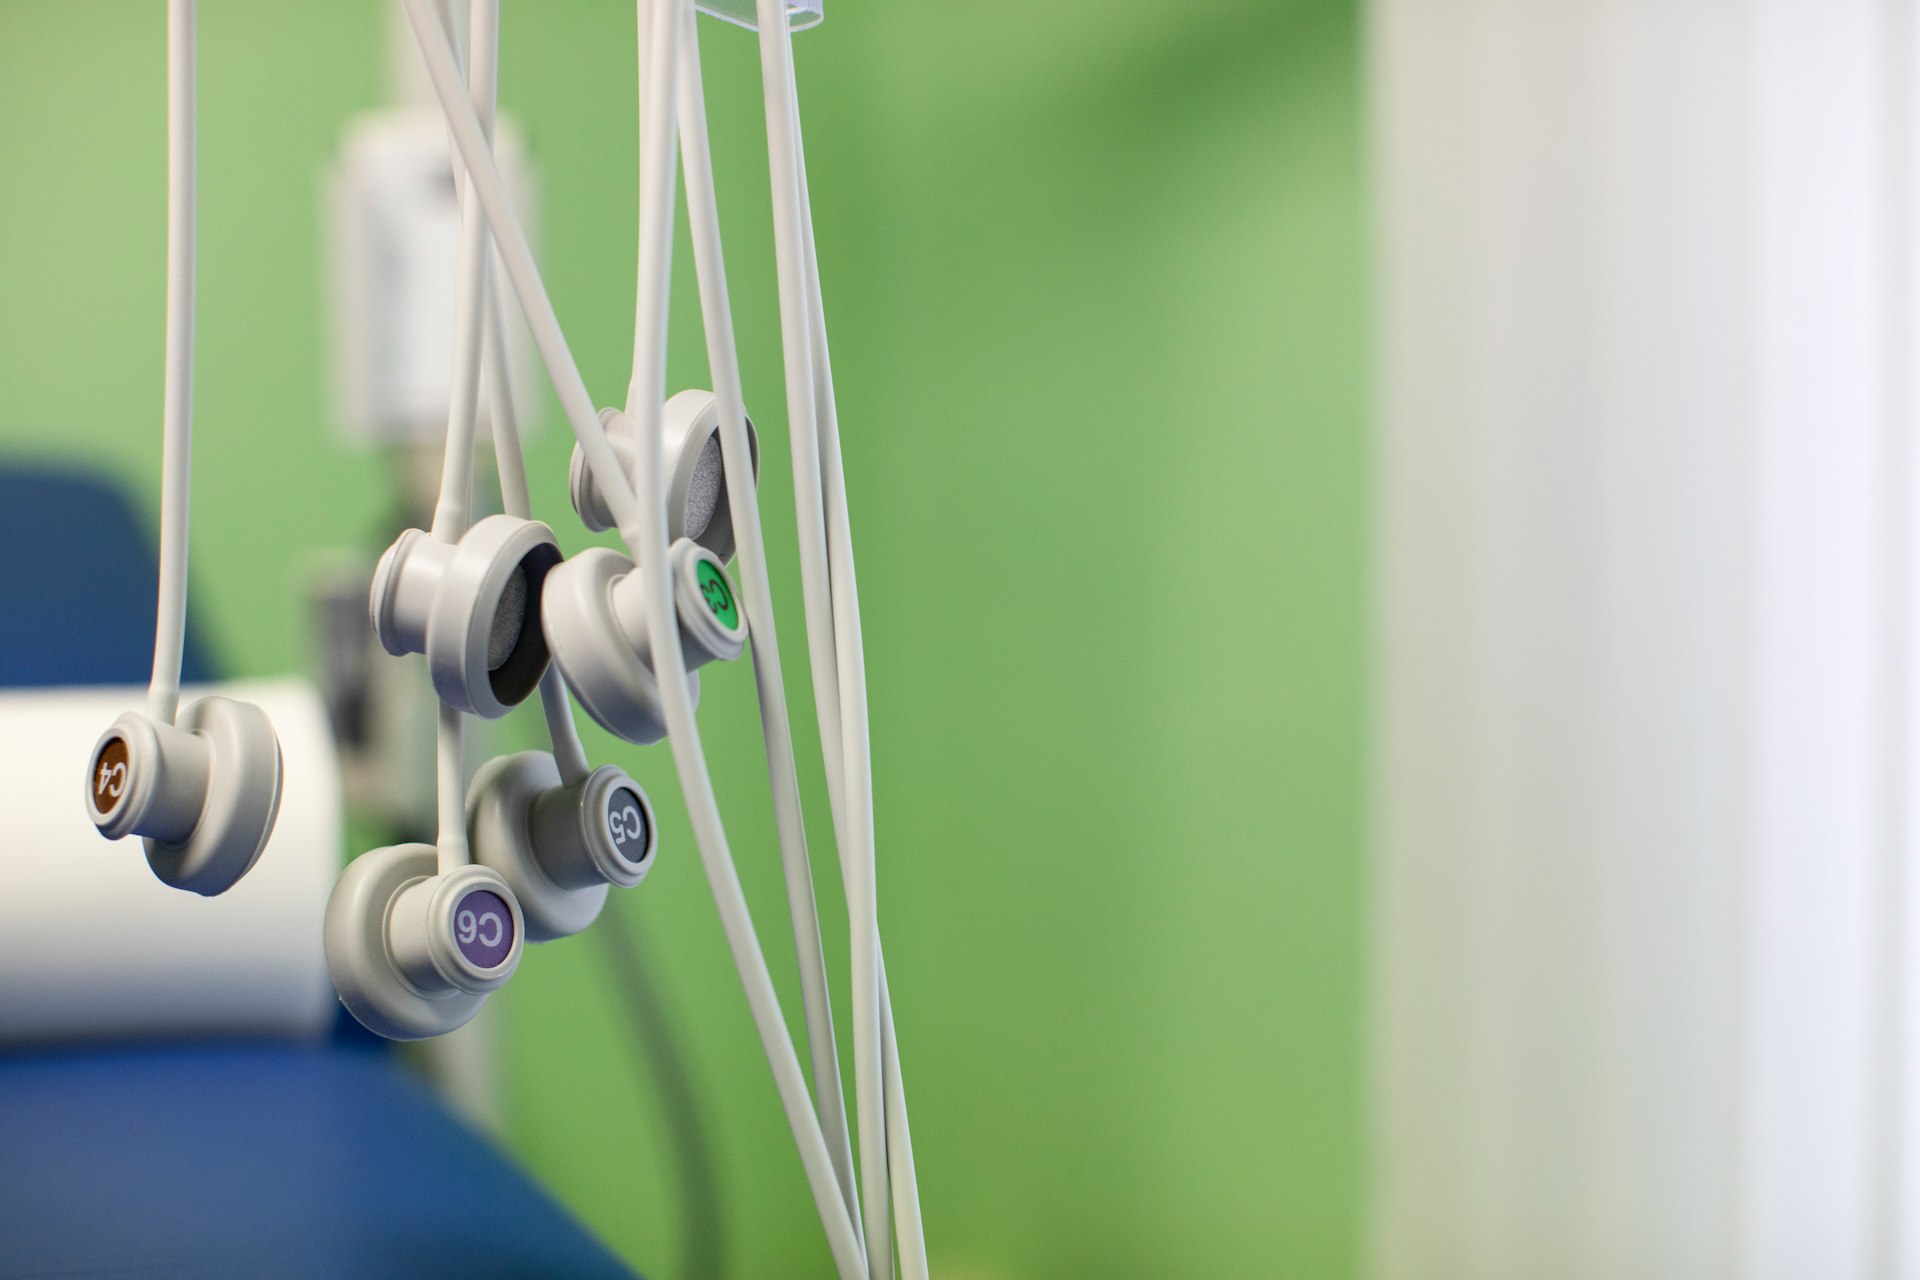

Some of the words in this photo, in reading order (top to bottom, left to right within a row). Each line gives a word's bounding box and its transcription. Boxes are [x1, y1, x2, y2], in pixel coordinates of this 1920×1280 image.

[700, 579, 729, 614] C3
[98, 762, 127, 797] C4
[609, 805, 641, 844] C5
[458, 910, 503, 948] C6
